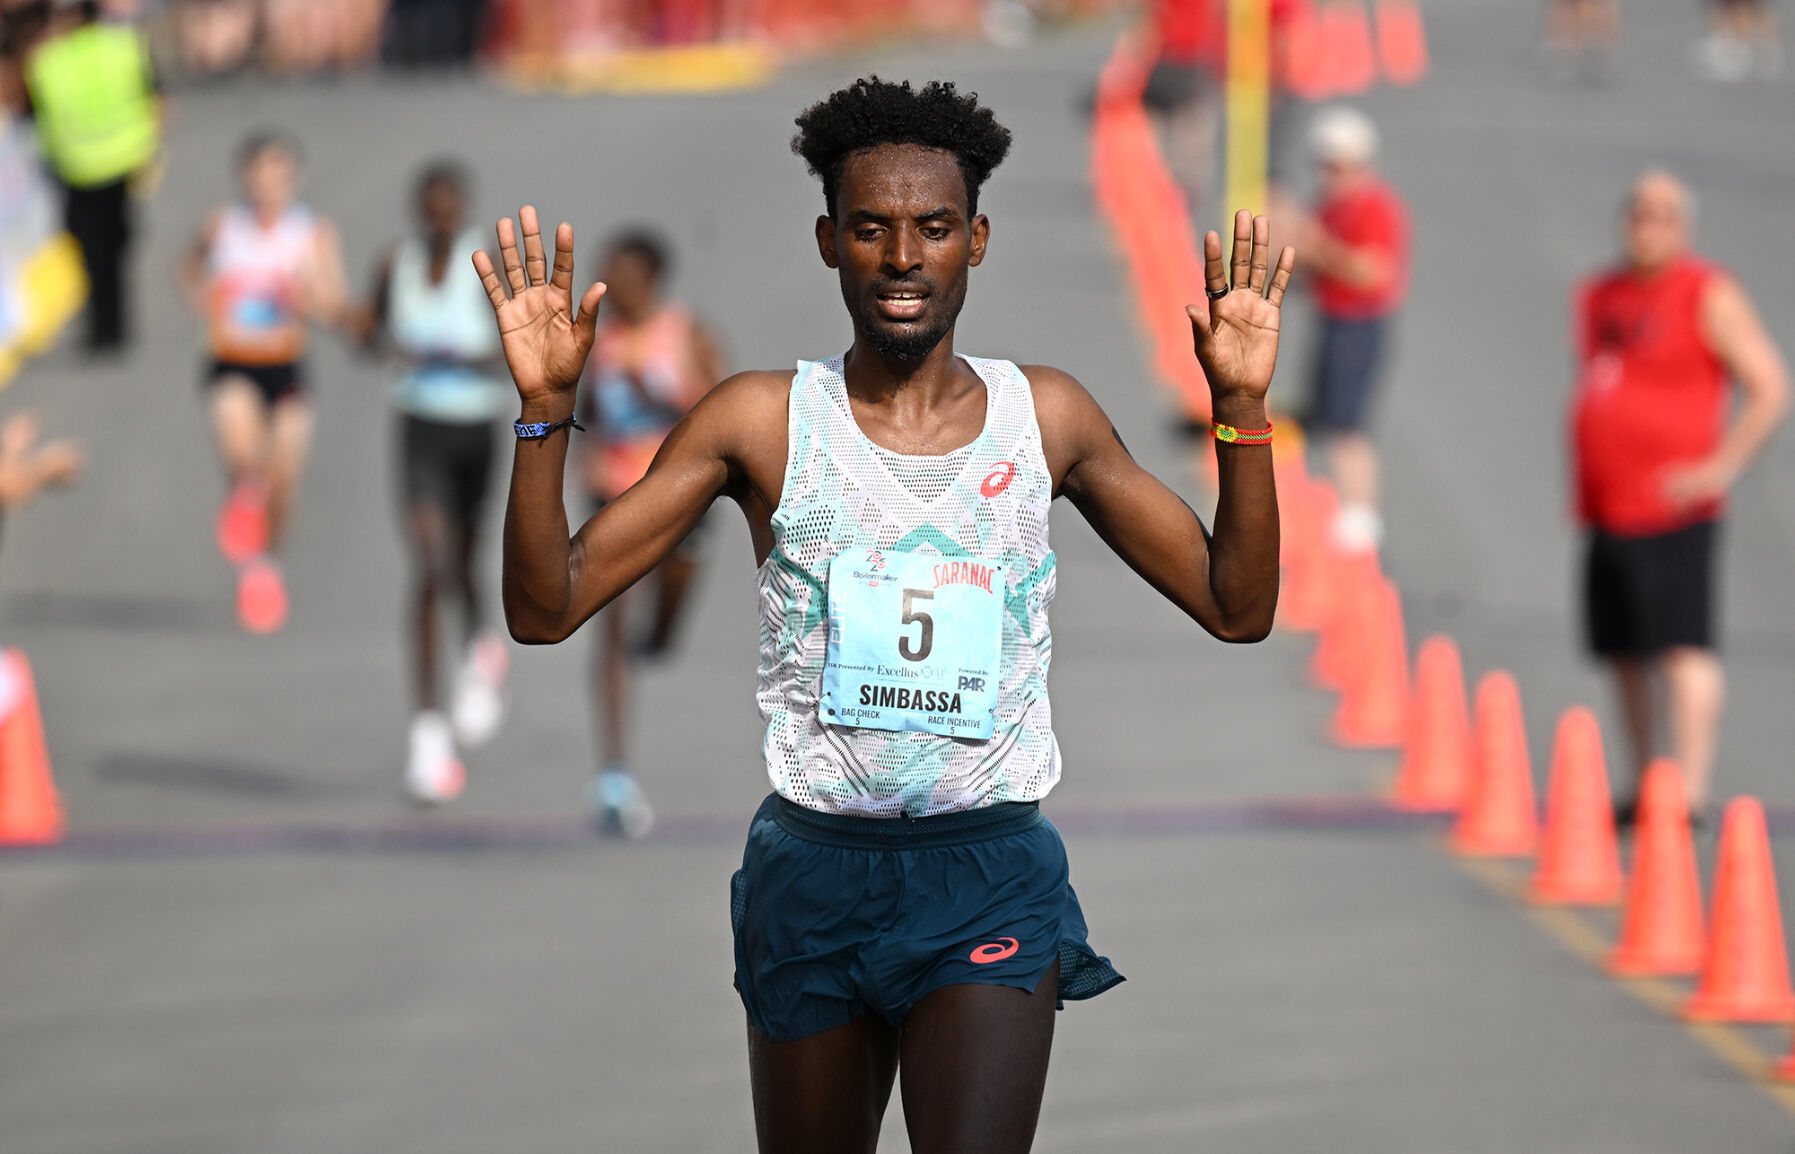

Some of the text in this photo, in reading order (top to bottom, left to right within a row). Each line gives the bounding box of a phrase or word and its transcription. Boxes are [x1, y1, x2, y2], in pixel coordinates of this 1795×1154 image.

[853, 570, 898, 582] Boilermaker
[933, 561, 995, 594] SARANAC
[831, 591, 847, 643] ELITE
[898, 588, 934, 662] 5
[838, 663, 867, 671] Presented
[877, 664, 919, 678] Excellus
[958, 667, 982, 675] Powered
[957, 675, 986, 692] PAR
[859, 684, 962, 714] SIMBASSA
[841, 707, 880, 719] BAG CHECK
[855, 718, 860, 726] 5
[927, 715, 981, 729] RACE INCENTIVE
[950, 726, 955, 735] 5
